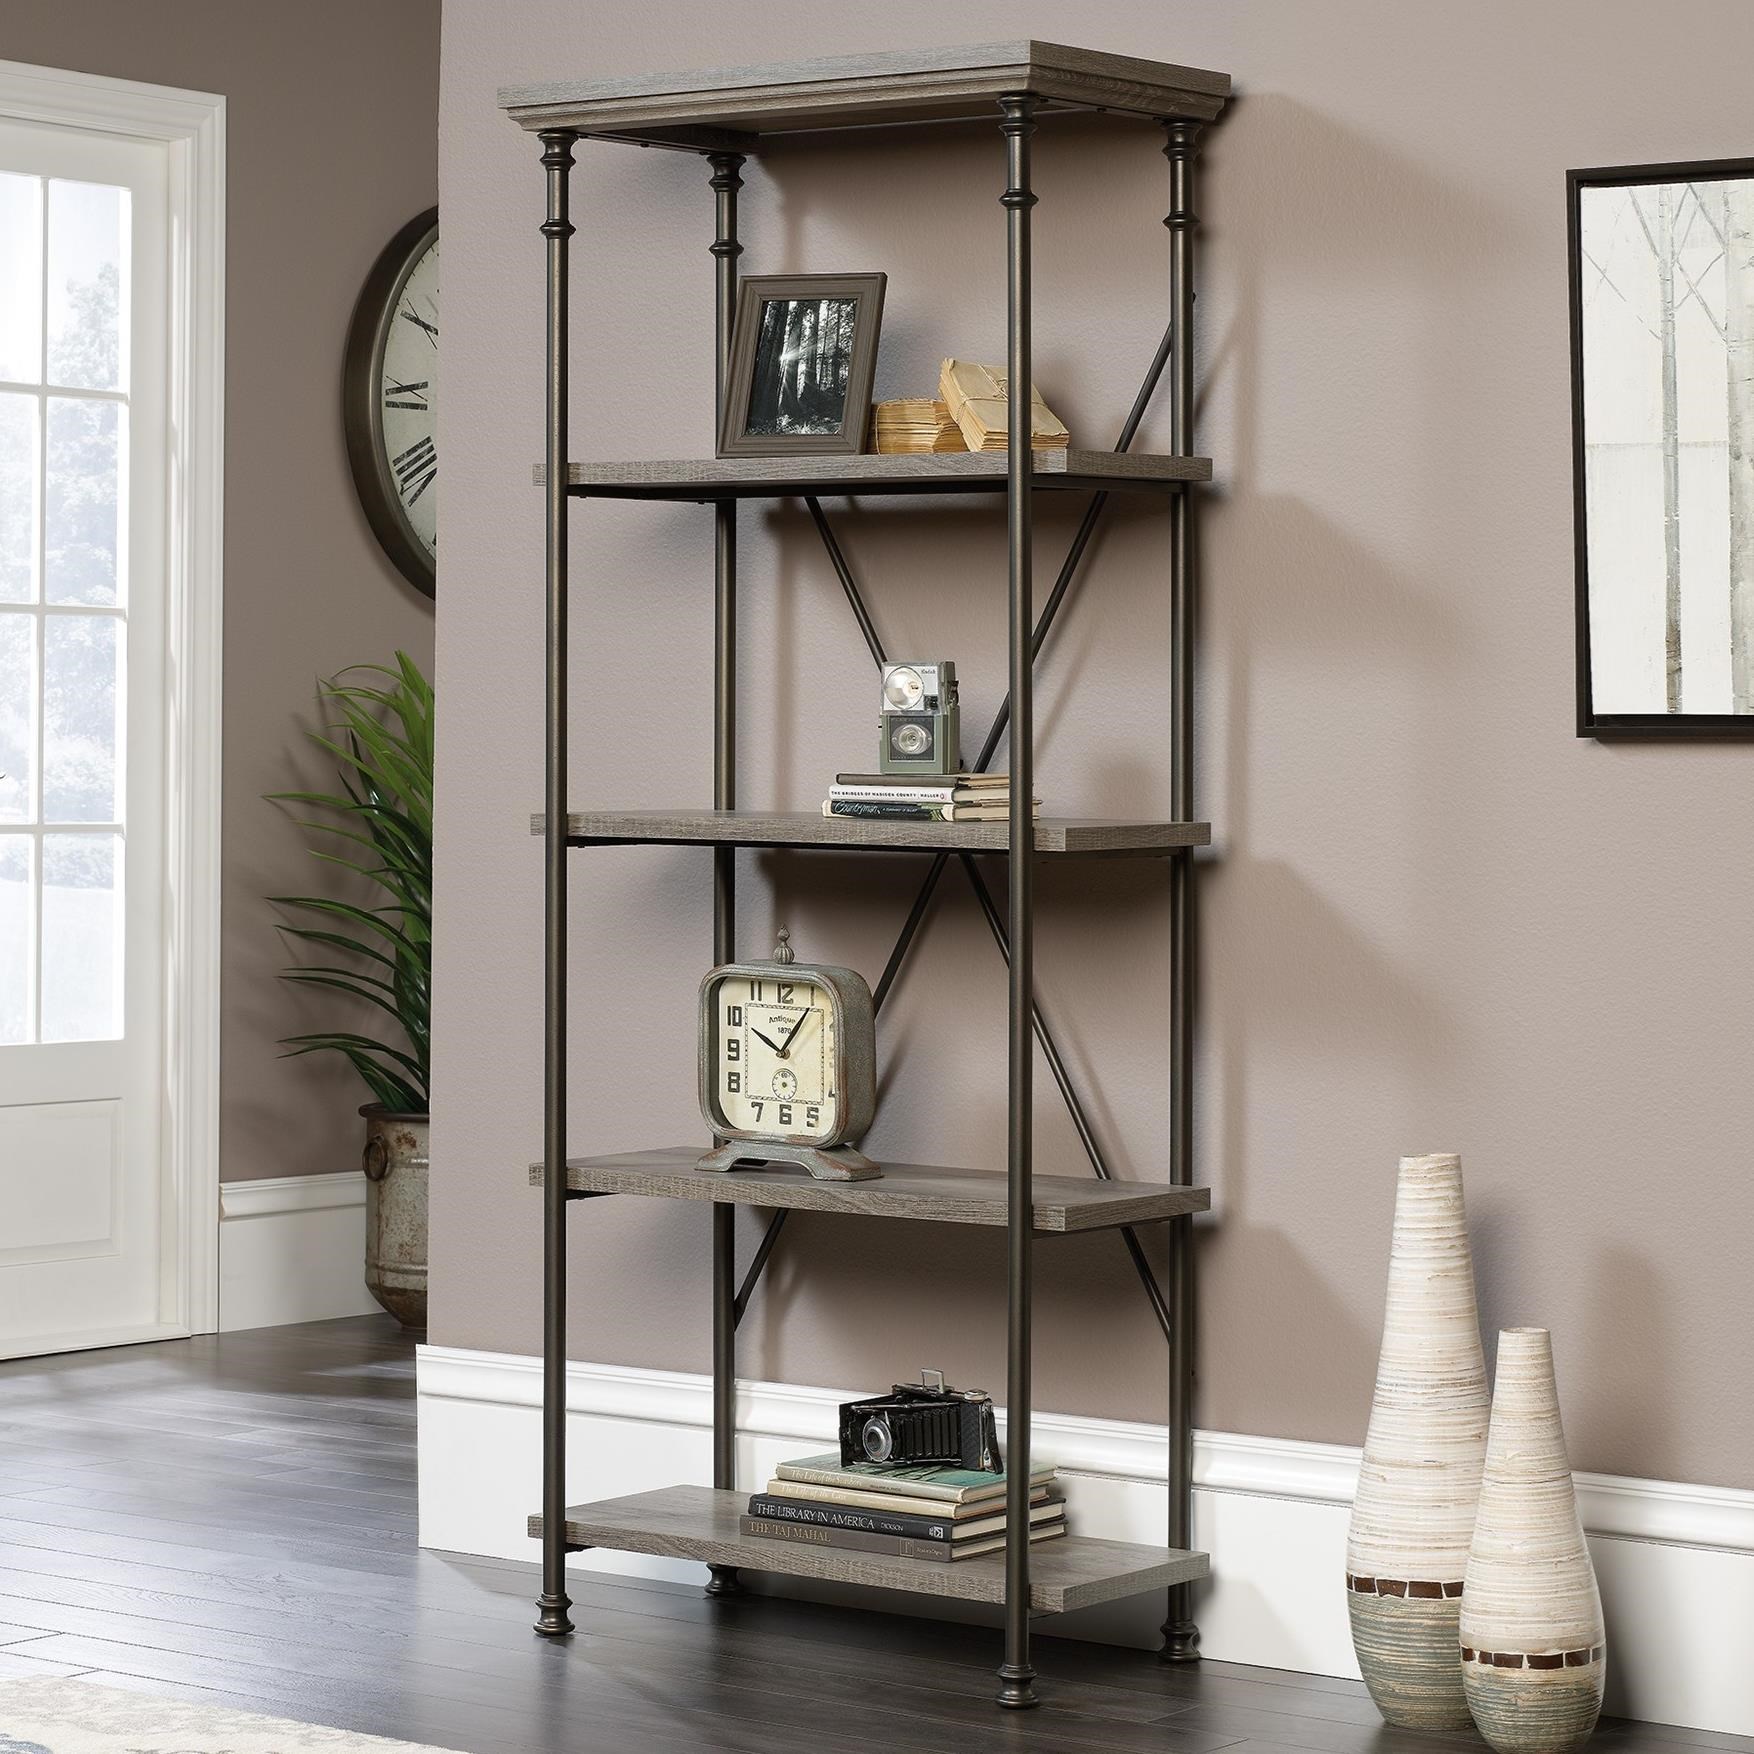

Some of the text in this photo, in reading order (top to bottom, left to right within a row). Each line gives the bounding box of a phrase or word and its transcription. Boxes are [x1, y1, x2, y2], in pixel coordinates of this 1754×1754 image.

[777, 983, 794, 1004] 12
[727, 1005, 742, 1027] 10
[768, 1015, 796, 1024] Antique
[727, 1039, 740, 1061] 9
[727, 1071, 741, 1093] 8
[751, 1102, 764, 1122] 7
[779, 1104, 792, 1125] 6
[806, 1106, 819, 1127] 5
[791, 1469, 803, 1480] The
[756, 1503, 776, 1516] THE
[777, 1506, 817, 1521] LIBRARY
[817, 1510, 829, 1523] IN
[830, 1513, 875, 1530] AMERICA
[749, 1520, 831, 1542] THE TAJ MAHAL
